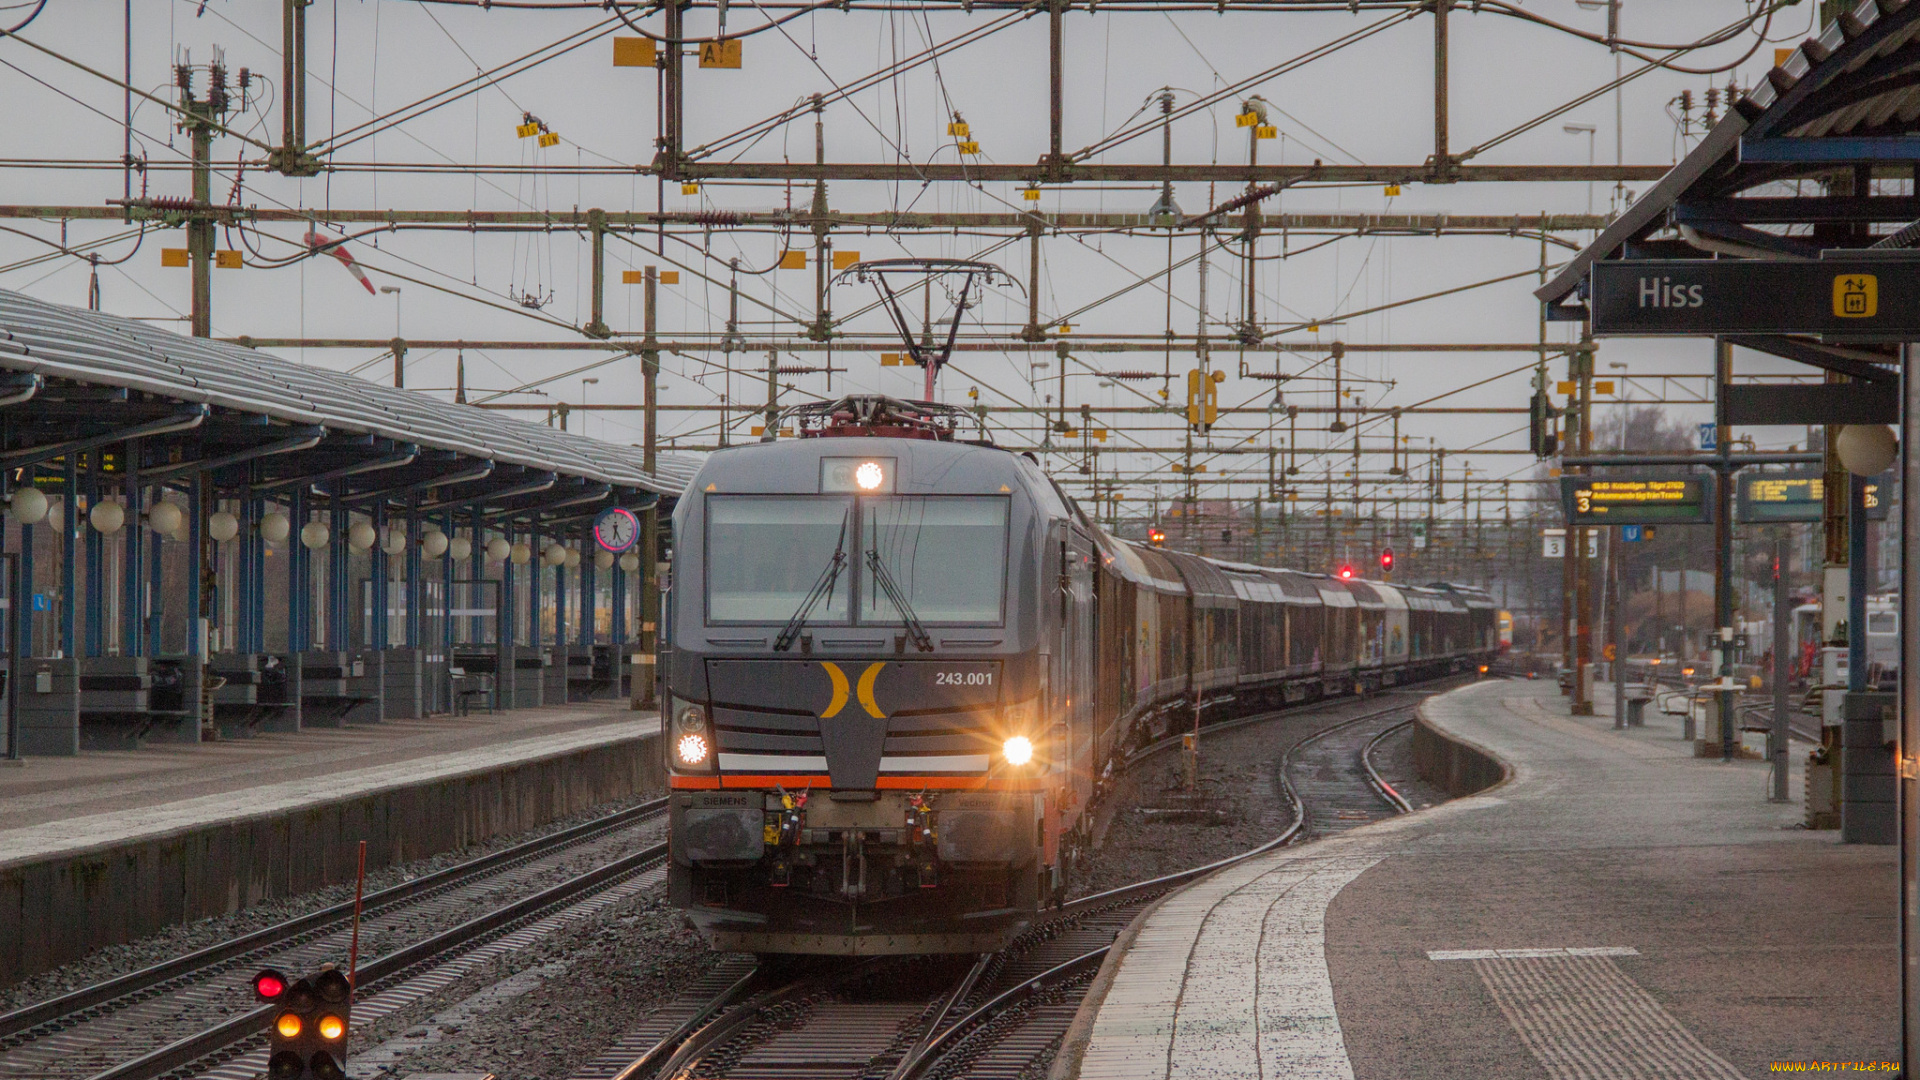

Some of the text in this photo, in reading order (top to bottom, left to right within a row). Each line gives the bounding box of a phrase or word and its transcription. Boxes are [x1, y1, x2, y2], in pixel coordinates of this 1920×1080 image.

[1639, 276, 1703, 308] Hiss
[14, 467, 24, 481] 7
[1577, 498, 1590, 513] 3
[1627, 527, 1637, 540] U
[1551, 543, 1559, 554] 3
[935, 672, 993, 686] 243.001
[703, 797, 747, 806] SIEMENS
